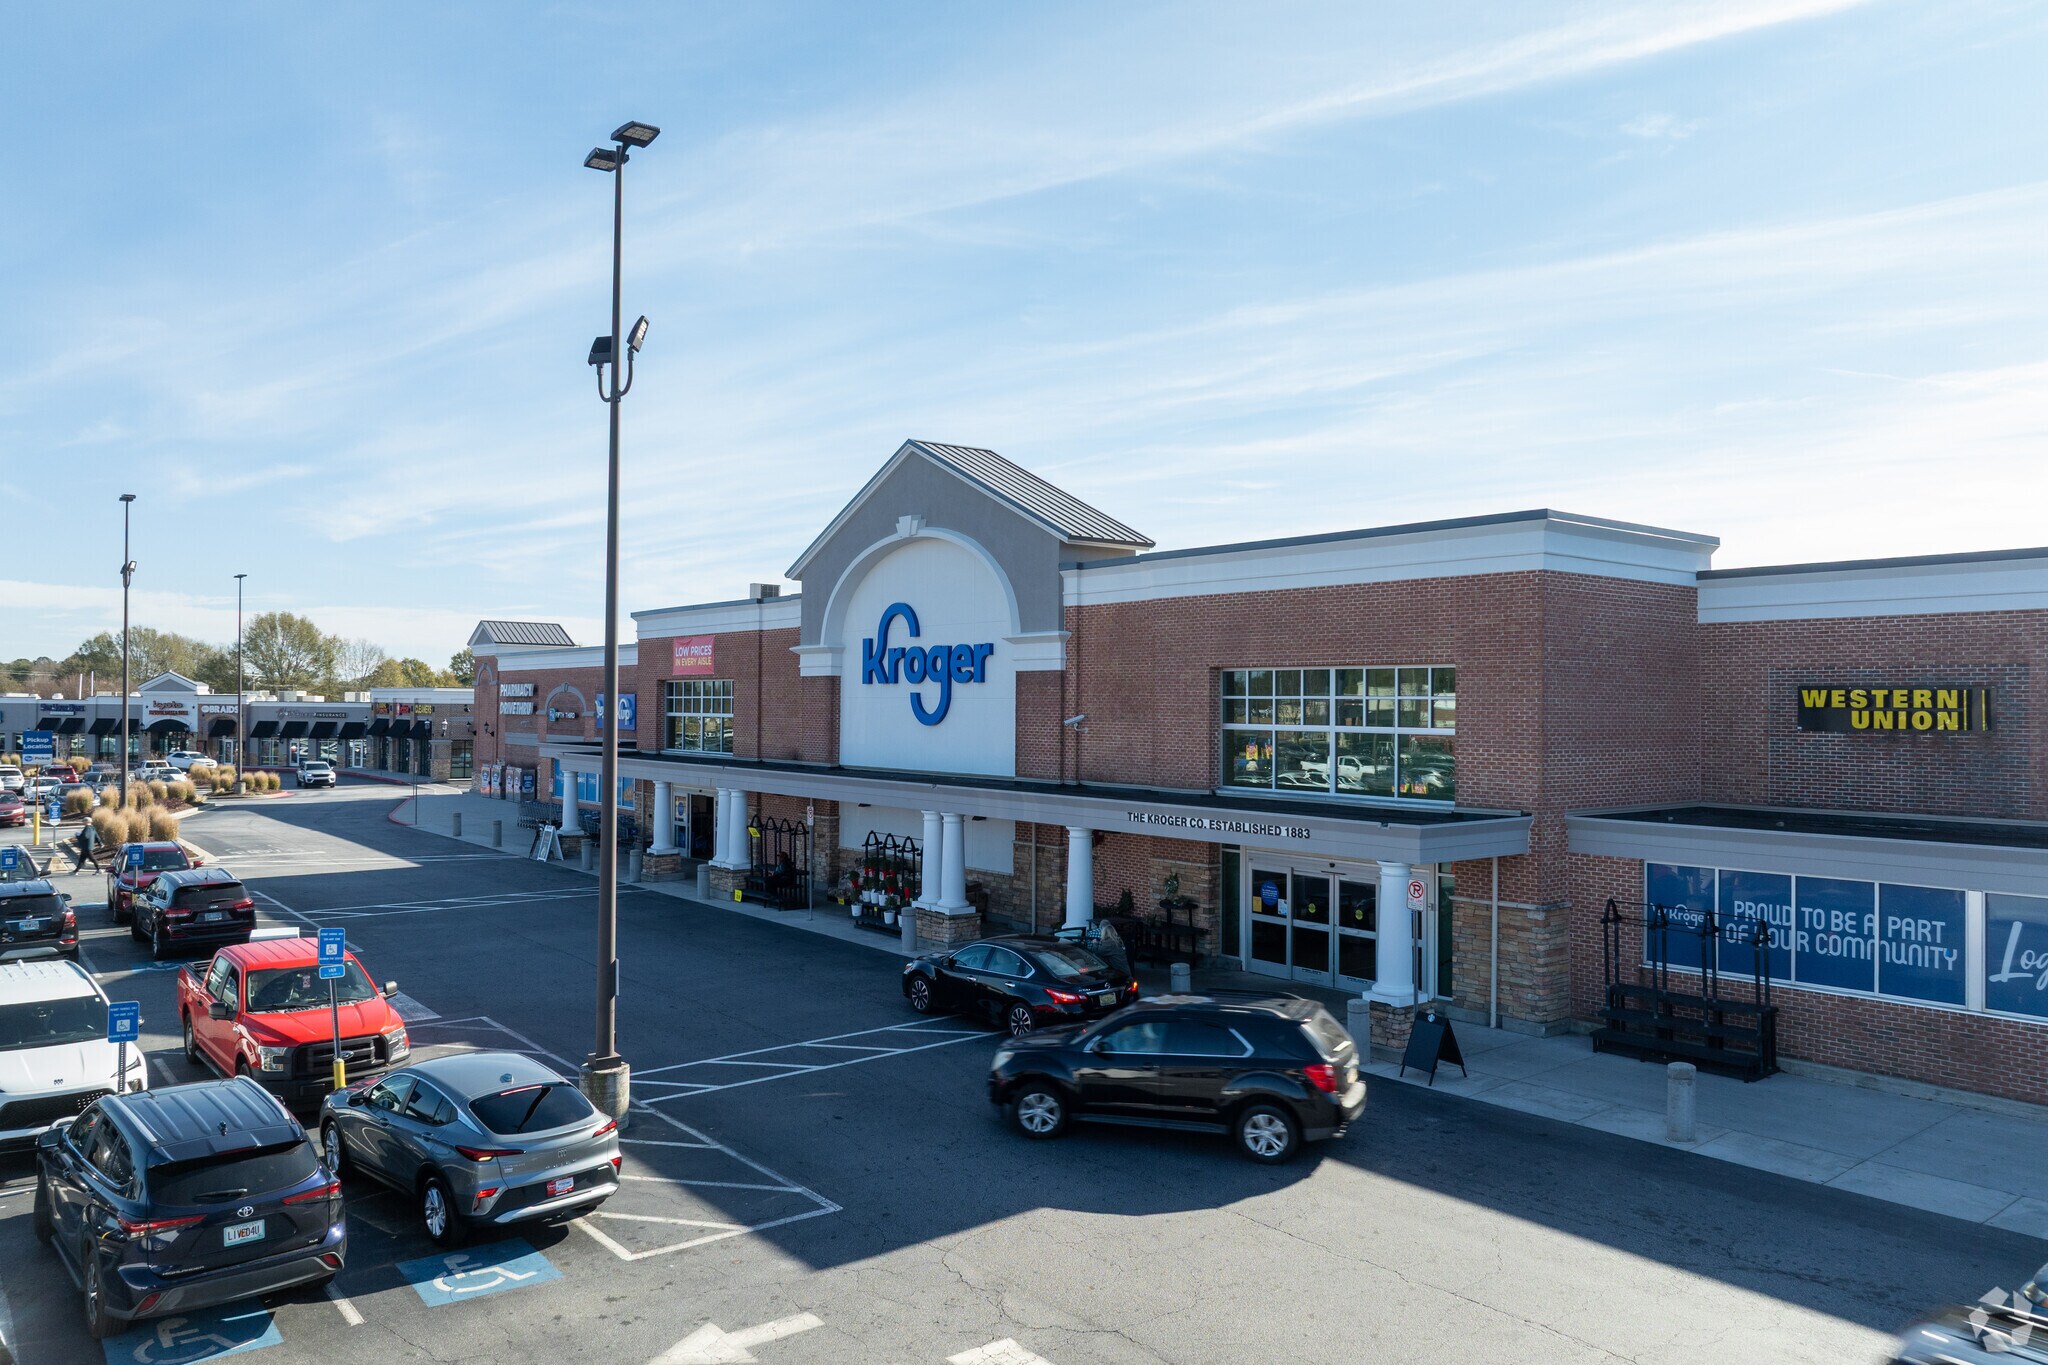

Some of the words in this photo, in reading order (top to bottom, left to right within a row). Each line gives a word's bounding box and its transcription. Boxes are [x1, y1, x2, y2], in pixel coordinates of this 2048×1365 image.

[675, 646, 690, 657] LOW
[690, 644, 712, 656] PRICES
[675, 658, 681, 666] IN
[681, 657, 697, 667] EVERY
[697, 656, 712, 666] AISLE
[862, 602, 994, 726] Kroger
[500, 683, 534, 697] PHARMACY
[1802, 689, 1958, 709] WESTERN
[1851, 710, 1958, 731] UNION
[1127, 811, 1146, 823] THE
[1147, 813, 1187, 827] KROGER
[1189, 817, 1207, 829] CO.
[1209, 819, 1282, 836] ESTABLISHED
[1284, 827, 1310, 839] 1883
[1733, 900, 1793, 927] PROUD
[1800, 906, 1826, 930] TO
[1830, 909, 1857, 934] BE
[1863, 913, 1877, 936] A
[1887, 916, 1946, 944] PART
[1725, 922, 1750, 944] OF
[1815, 932, 1958, 971] COMMUNITY
